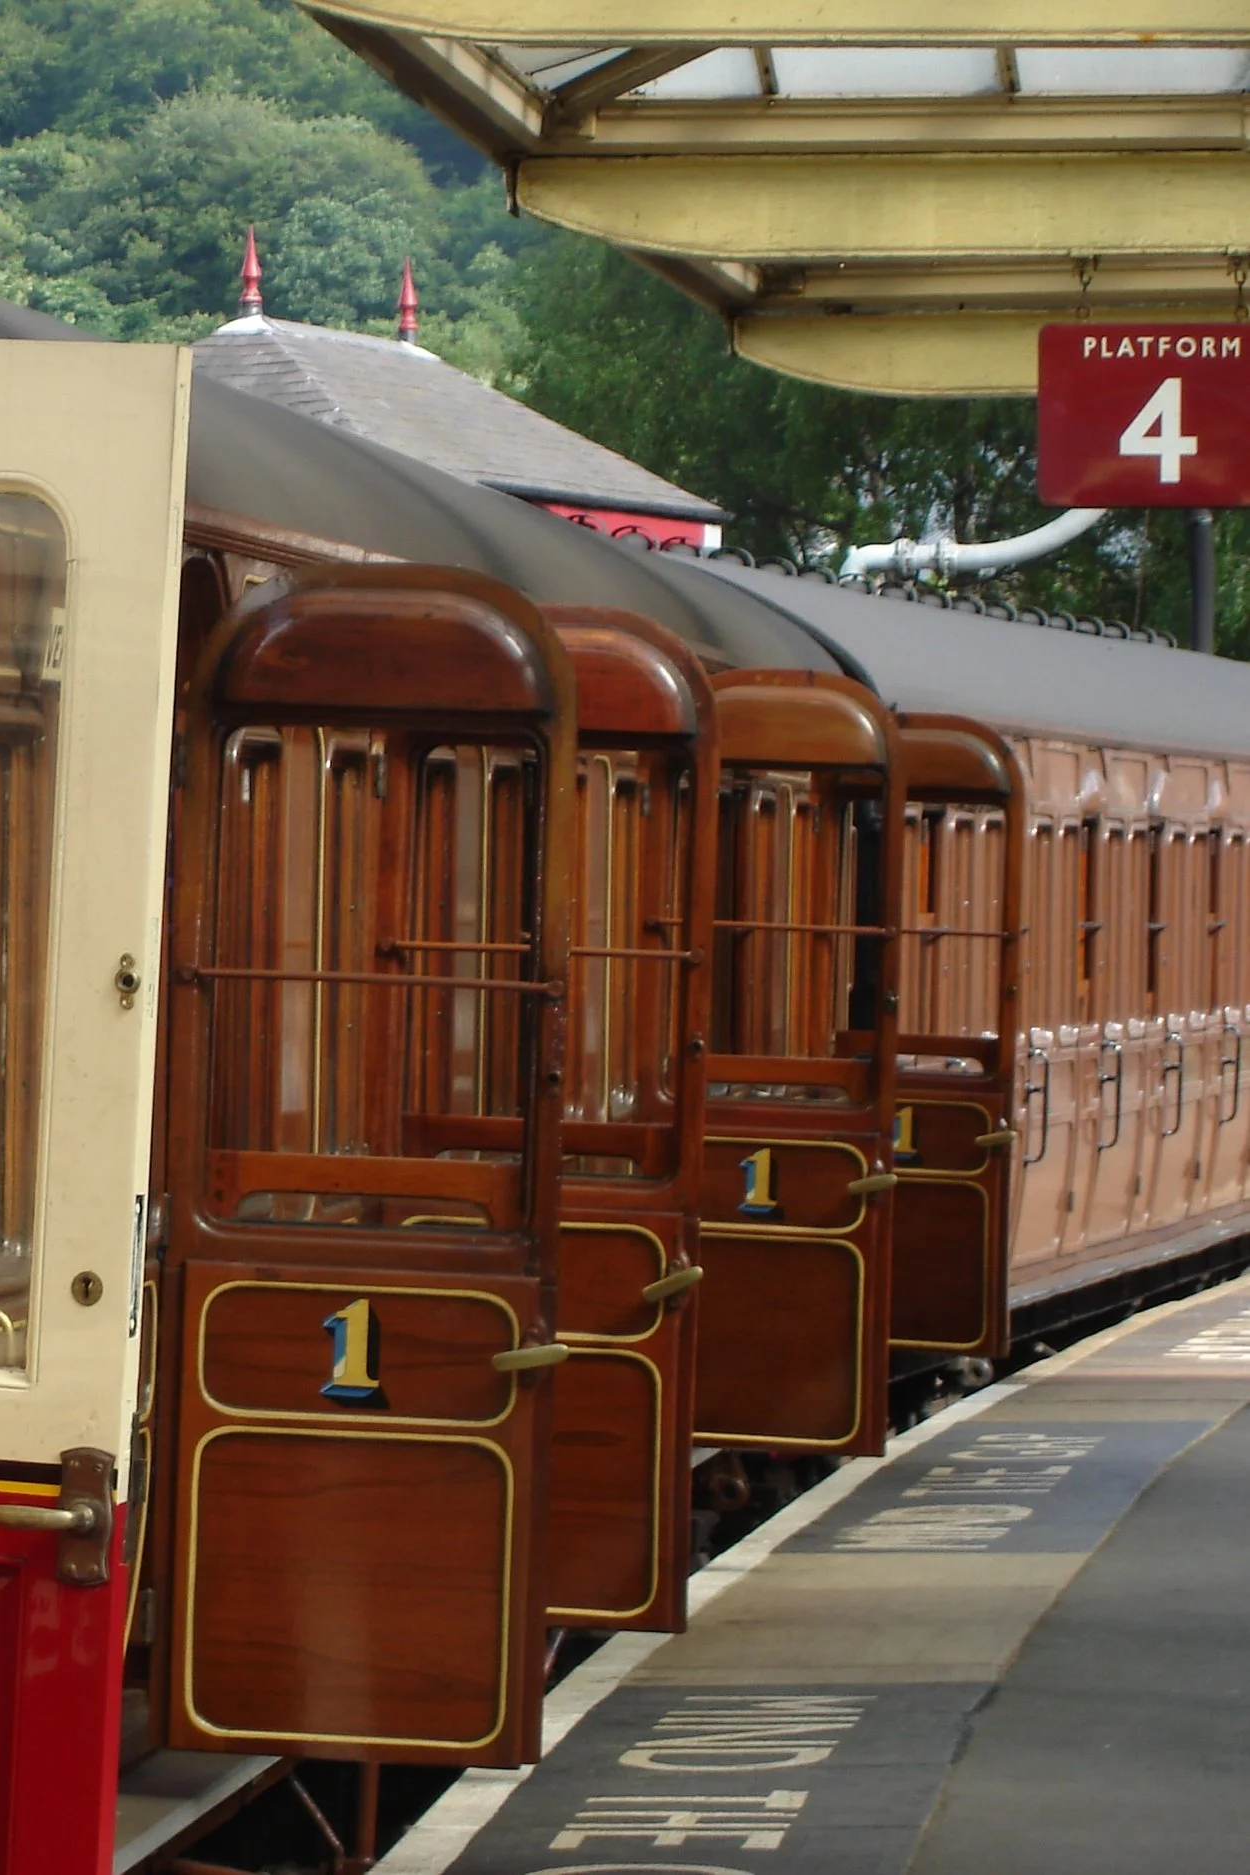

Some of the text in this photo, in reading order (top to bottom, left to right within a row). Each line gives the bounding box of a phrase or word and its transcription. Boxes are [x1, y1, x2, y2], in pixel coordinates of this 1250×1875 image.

[1082, 335, 1241, 359] PLATFORM
[1118, 376, 1199, 484] 4
[893, 1106, 917, 1159] 1
[738, 1147, 777, 1214] 1
[320, 1298, 380, 1398] 1
[831, 1432, 1106, 1549] MIND THE GAP
[617, 1694, 879, 1773] MIND
[548, 1789, 810, 1850] THE
